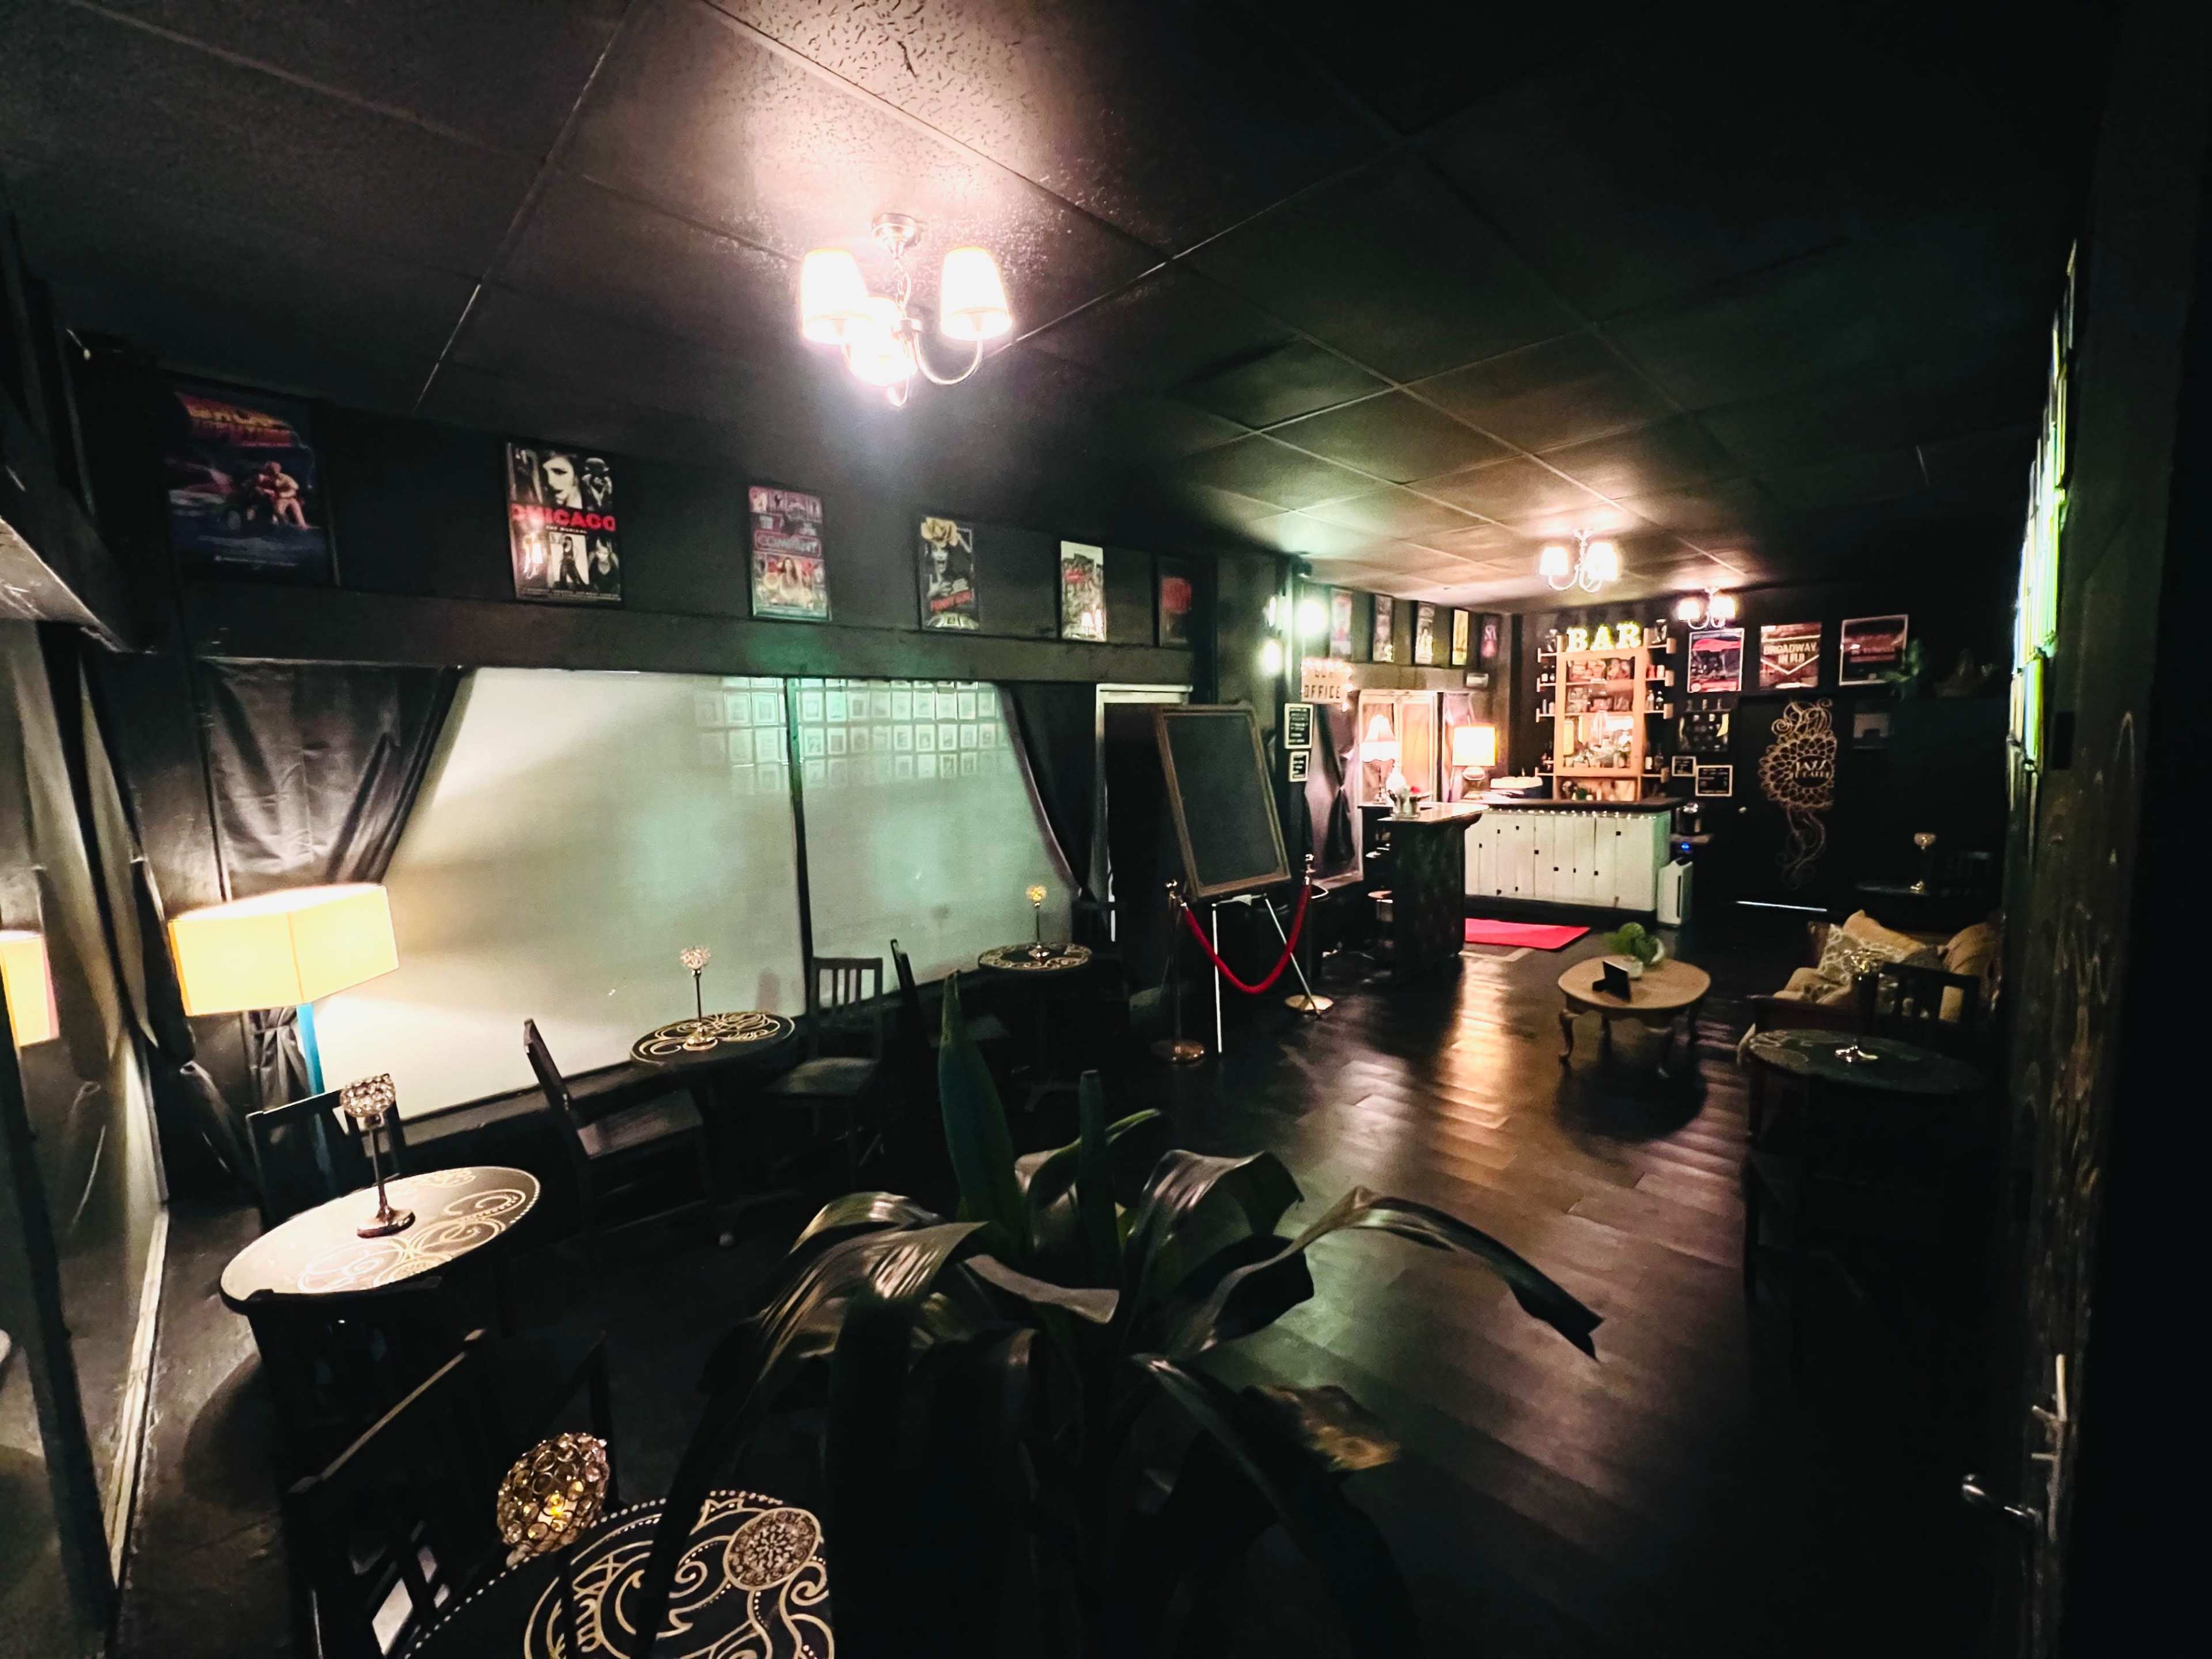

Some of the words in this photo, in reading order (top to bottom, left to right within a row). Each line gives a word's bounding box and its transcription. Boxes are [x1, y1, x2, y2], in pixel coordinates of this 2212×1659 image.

[510, 503, 616, 532] CHICAGO
[1566, 621, 1641, 653] BAR
[1763, 642, 1817, 655] BROADWAY
[1304, 684, 1340, 699] OFFICE
